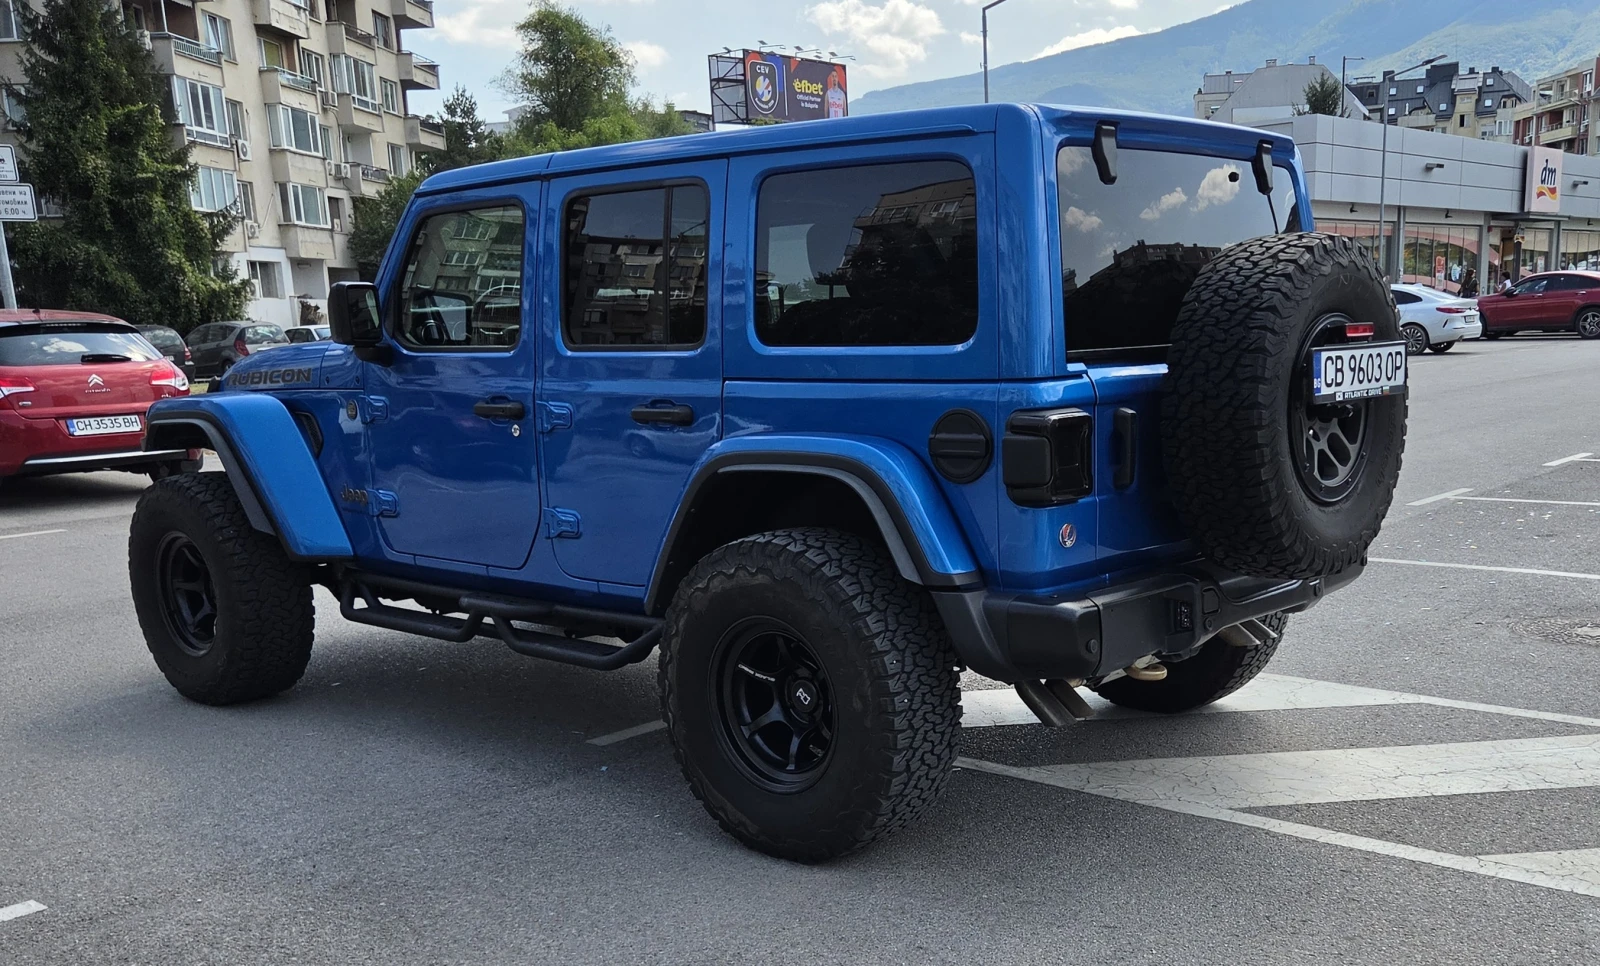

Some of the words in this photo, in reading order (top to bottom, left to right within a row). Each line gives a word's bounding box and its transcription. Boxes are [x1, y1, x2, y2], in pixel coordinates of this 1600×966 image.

[756, 65, 769, 74] CEV
[794, 79, 823, 96] efbet
[1540, 158, 1557, 186] dm
[226, 367, 313, 386] RUBICON
[1324, 355, 1345, 388] CB
[1348, 352, 1383, 386] 9603
[1385, 350, 1403, 381] OP
[1344, 389, 1368, 399] ATLANTIC
[76, 419, 92, 431] CH
[95, 417, 122, 430] 3535
[124, 416, 139, 428] BH
[341, 483, 368, 506] Jeep
